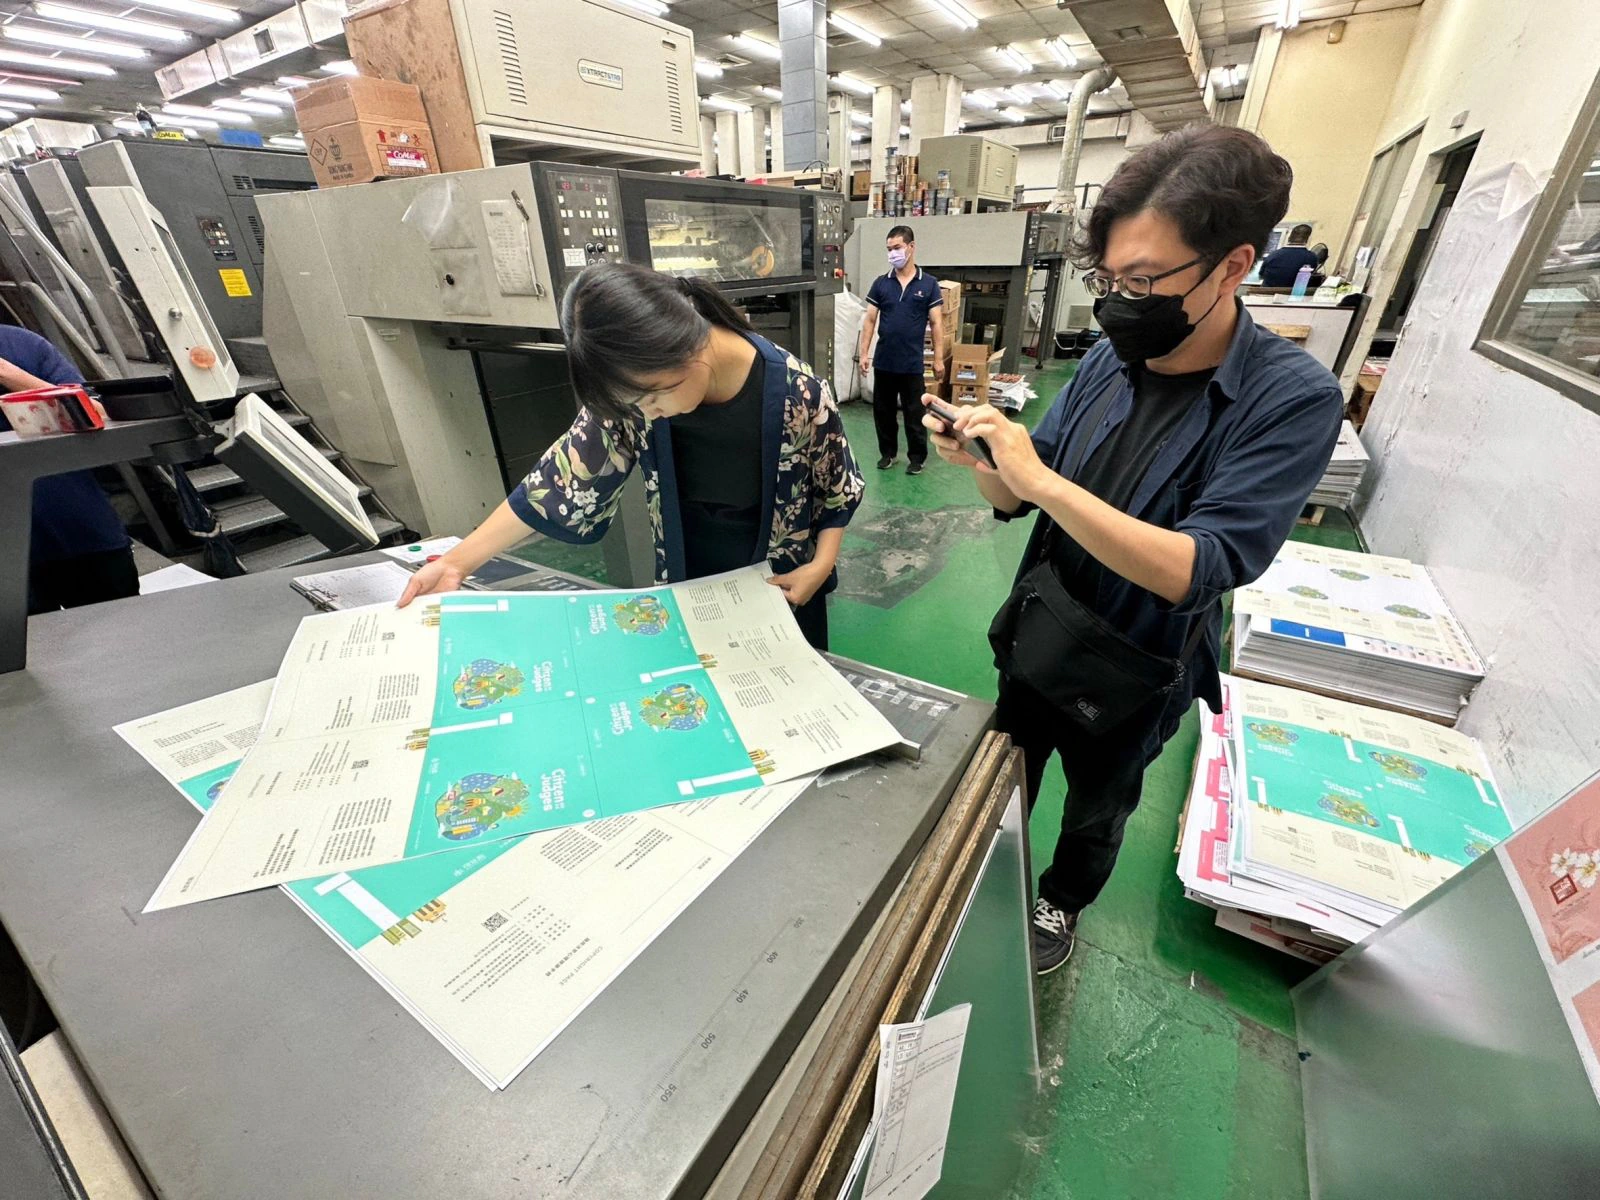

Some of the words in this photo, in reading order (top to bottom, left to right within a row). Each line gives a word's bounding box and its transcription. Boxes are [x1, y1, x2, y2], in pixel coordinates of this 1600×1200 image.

[539, 773, 553, 812] Judges
[551, 767, 567, 804] Citizen
[766, 951, 778, 964] 400
[735, 988, 749, 1004] 450
[701, 1032, 717, 1050] 500
[660, 1083, 677, 1102] 550
